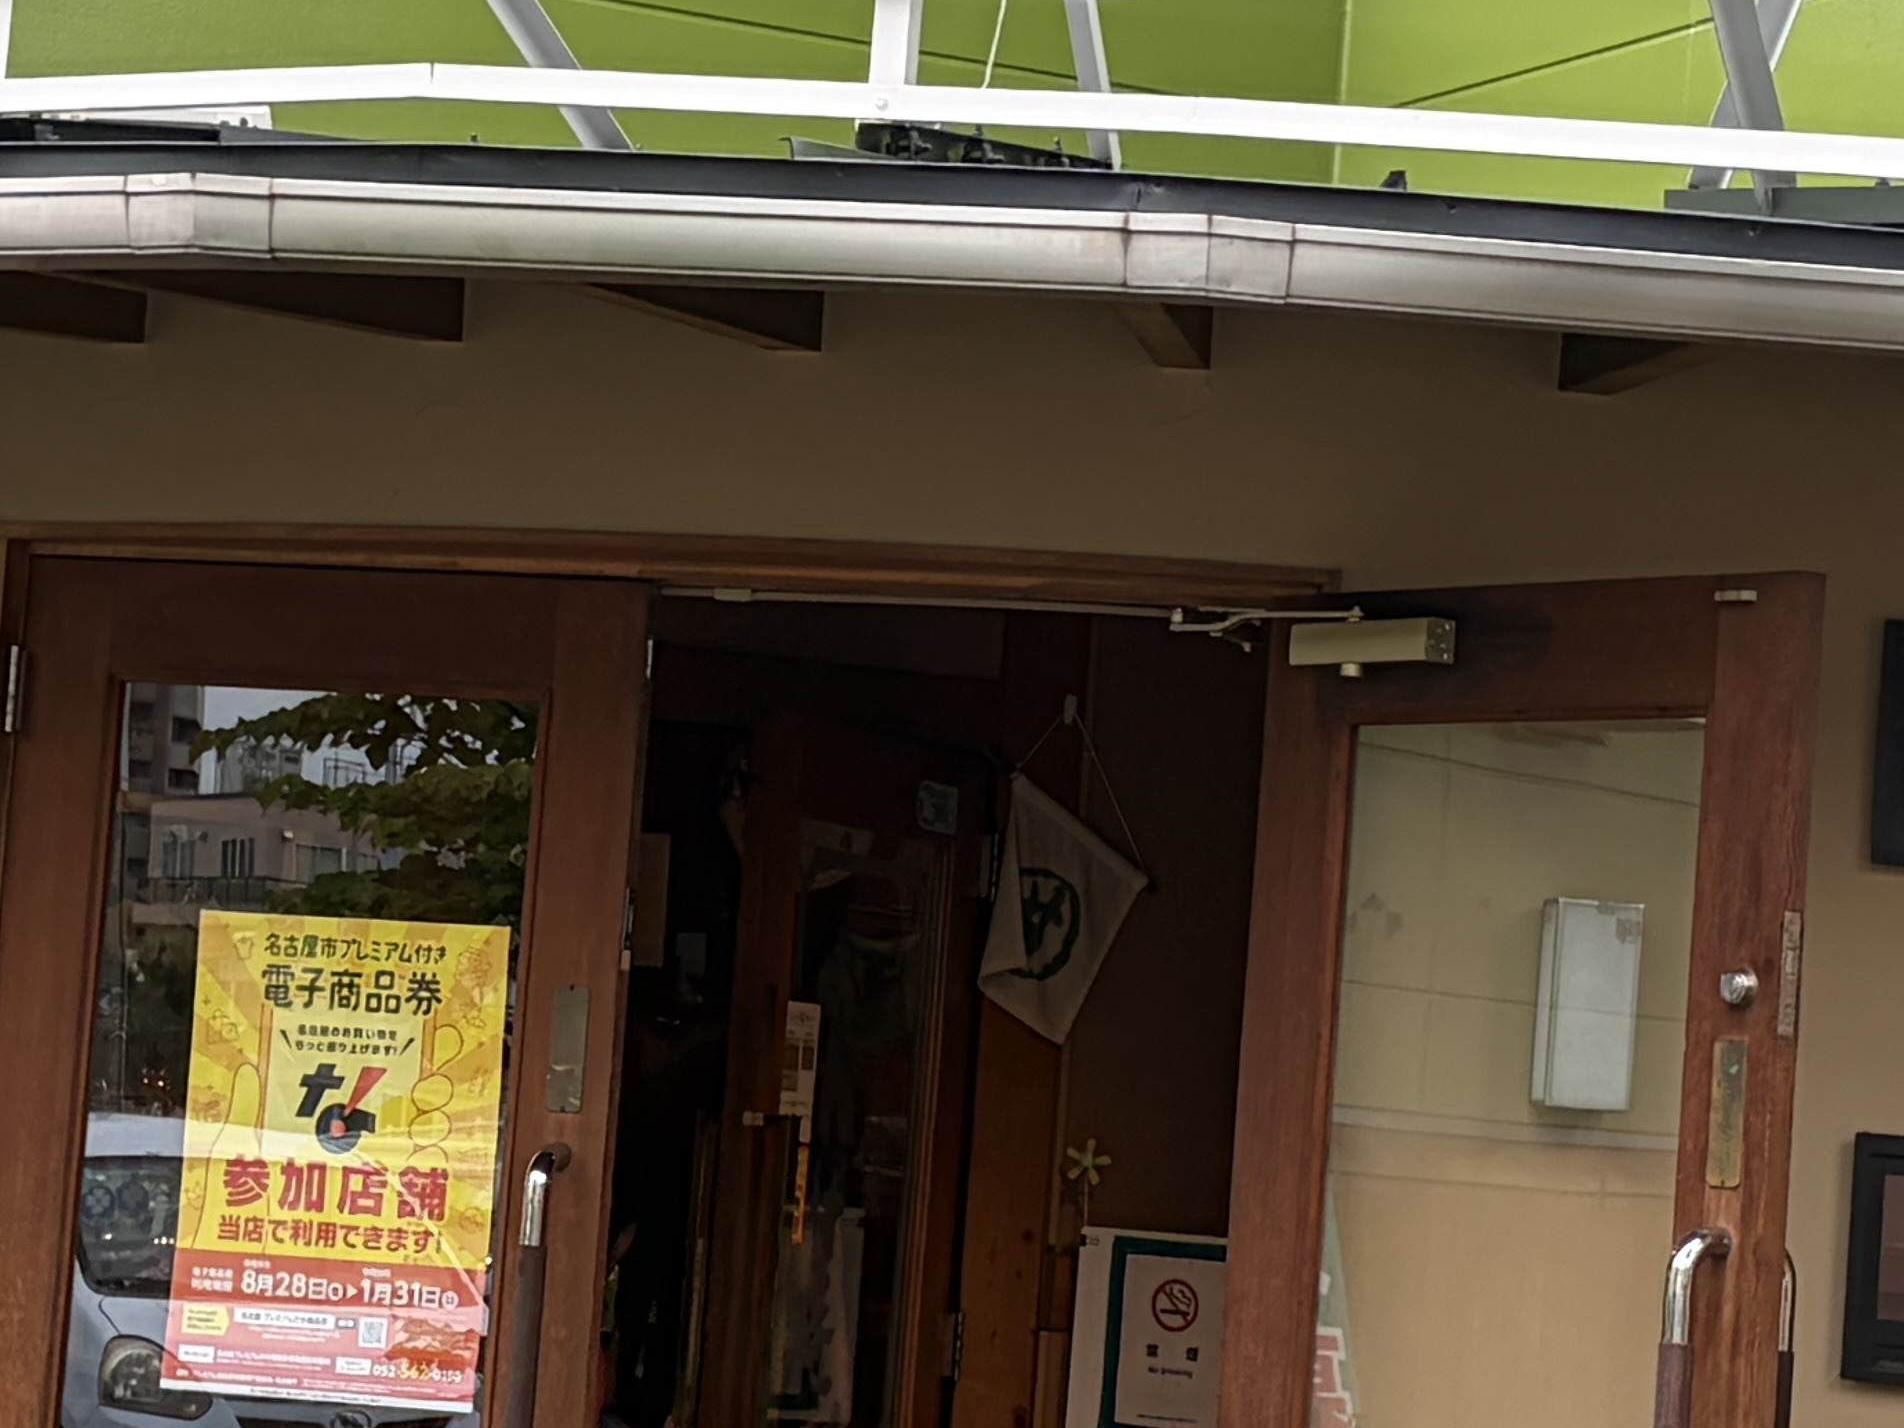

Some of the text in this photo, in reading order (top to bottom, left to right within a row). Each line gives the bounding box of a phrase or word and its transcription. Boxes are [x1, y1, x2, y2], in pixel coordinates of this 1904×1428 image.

[264, 932, 446, 965] 名古屋市プレミアム付き
[262, 964, 443, 1016] 電子商品券
[223, 1153, 449, 1222] 参加店舗
[217, 1214, 444, 1254] 当店で利用できます!
